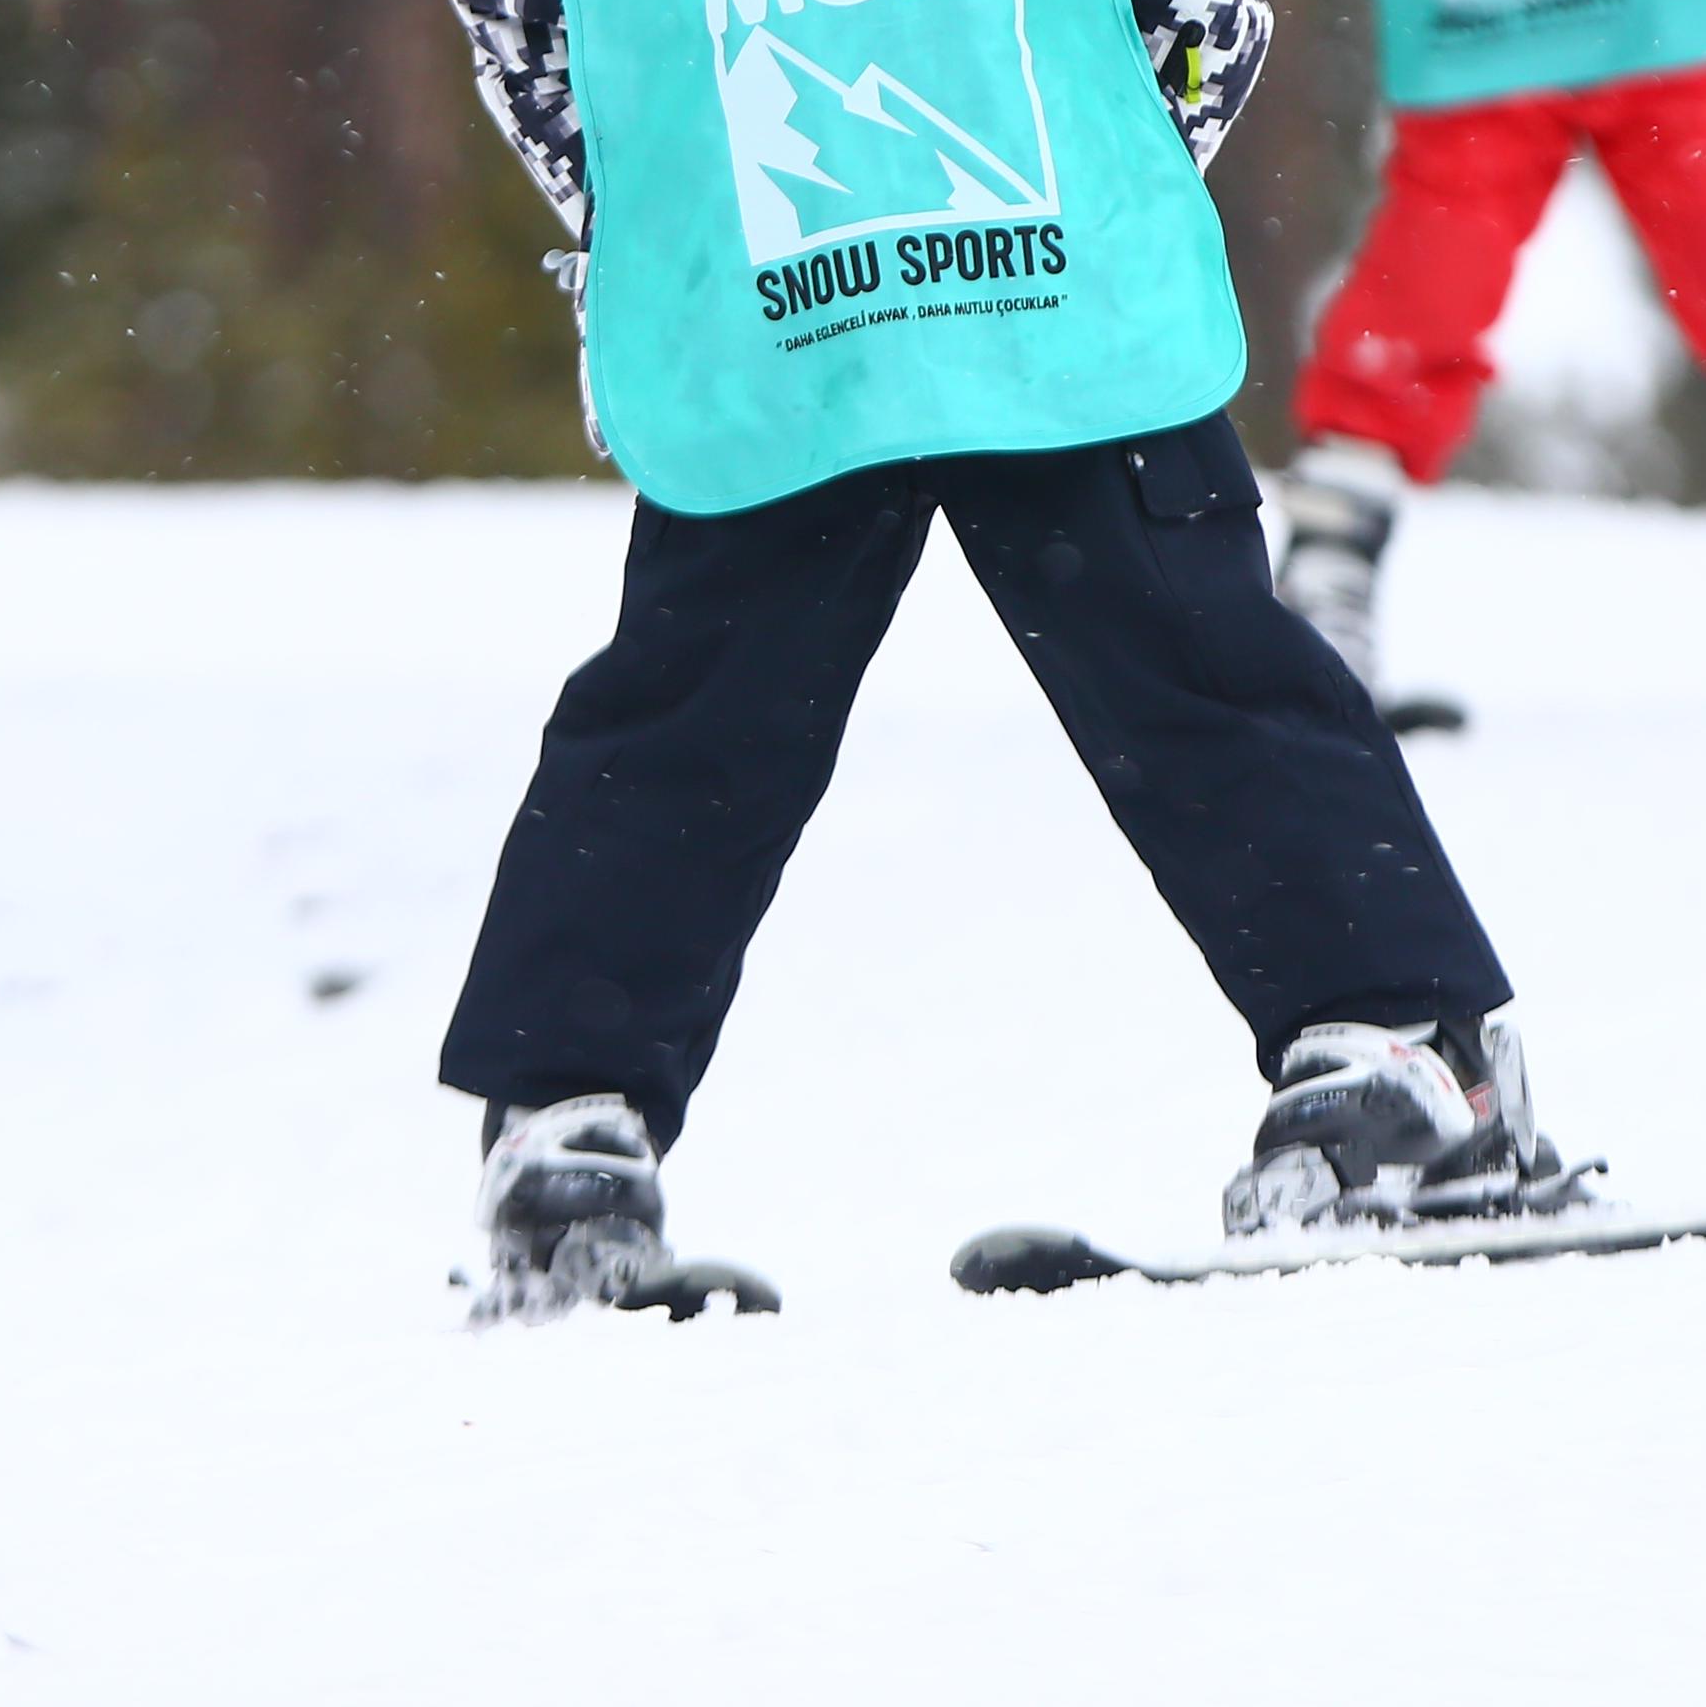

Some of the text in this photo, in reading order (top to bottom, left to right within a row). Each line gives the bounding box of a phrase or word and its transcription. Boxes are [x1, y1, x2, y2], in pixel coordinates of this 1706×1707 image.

[756, 223, 1067, 321] SNOW SPORTS
[785, 331, 815, 352] DAHA
[868, 306, 909, 325] KAYAK
[917, 303, 952, 319] DAHA
[954, 299, 994, 315] MUTLU
